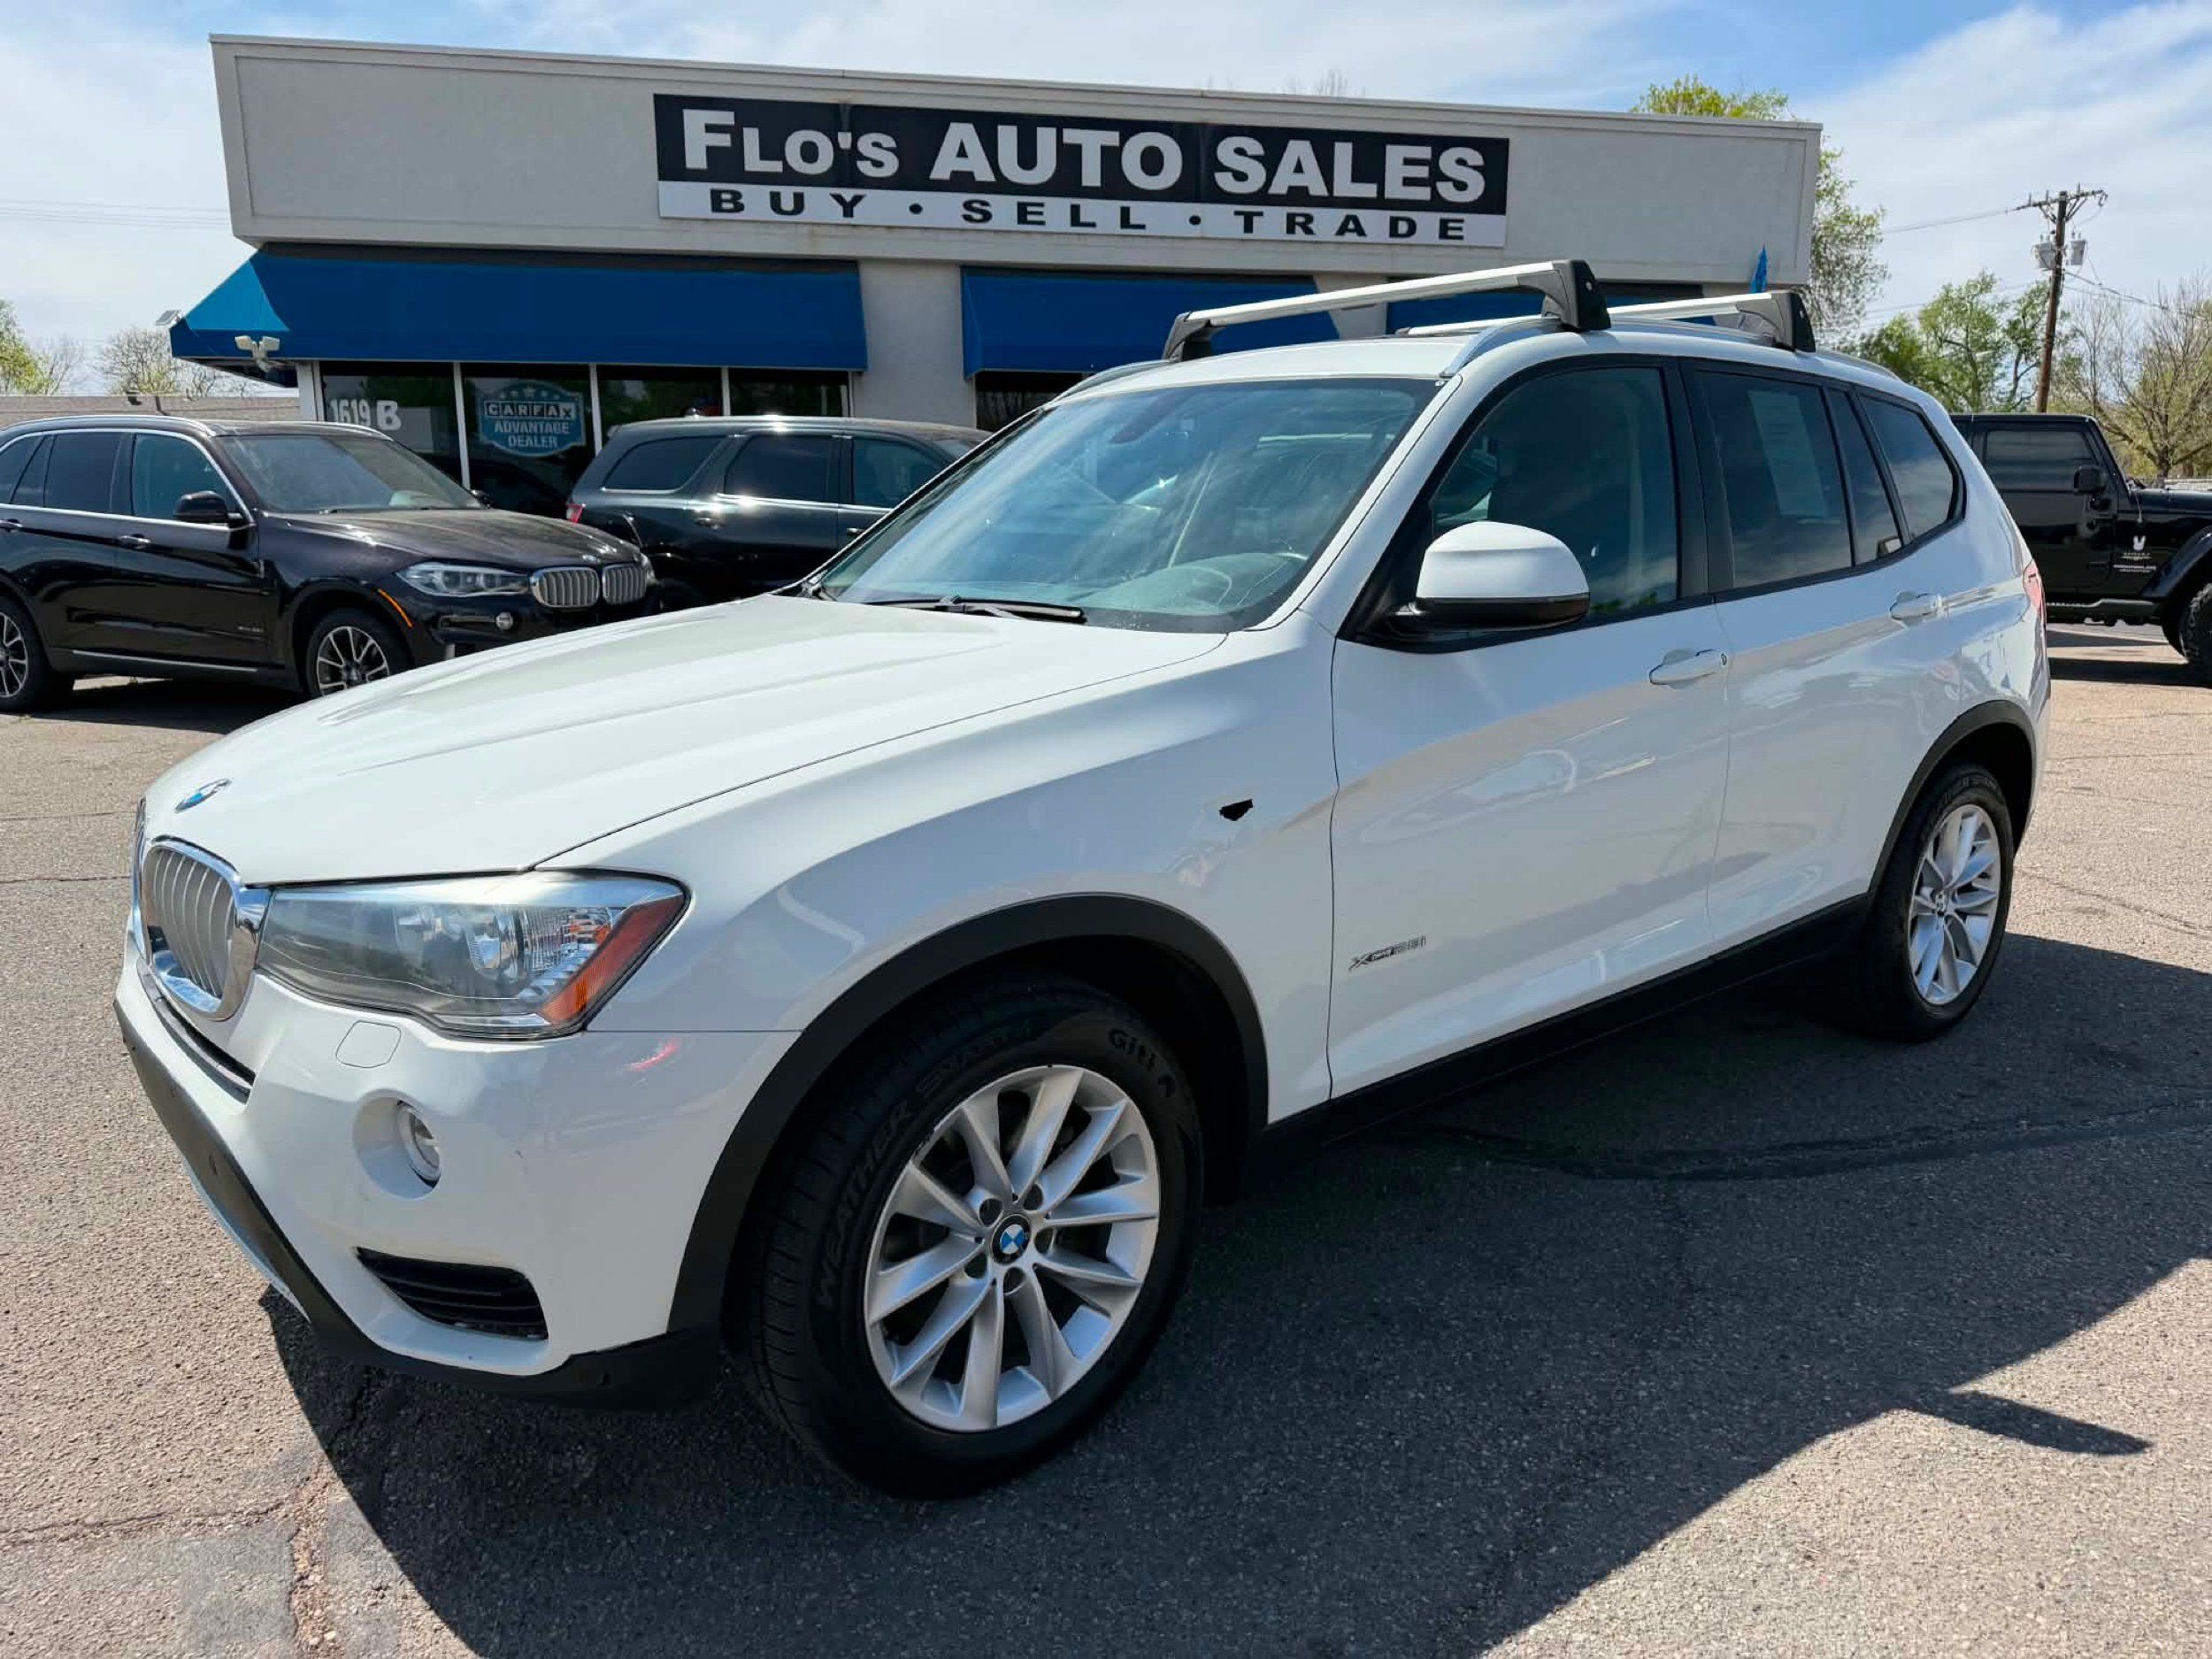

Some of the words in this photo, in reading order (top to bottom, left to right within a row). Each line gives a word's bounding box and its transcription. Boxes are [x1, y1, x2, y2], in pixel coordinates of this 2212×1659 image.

[929, 122, 1183, 191] AUTO
[1213, 135, 1486, 204] SALES
[710, 188, 867, 219] BUY
[962, 198, 1147, 230] SELL
[1233, 210, 1465, 242] TRADE
[328, 399, 372, 426] 1619
[376, 400, 402, 431] B
[487, 403, 573, 419] CARFAX
[493, 420, 572, 434] ADVANTAGE
[507, 434, 558, 449] DEALER
